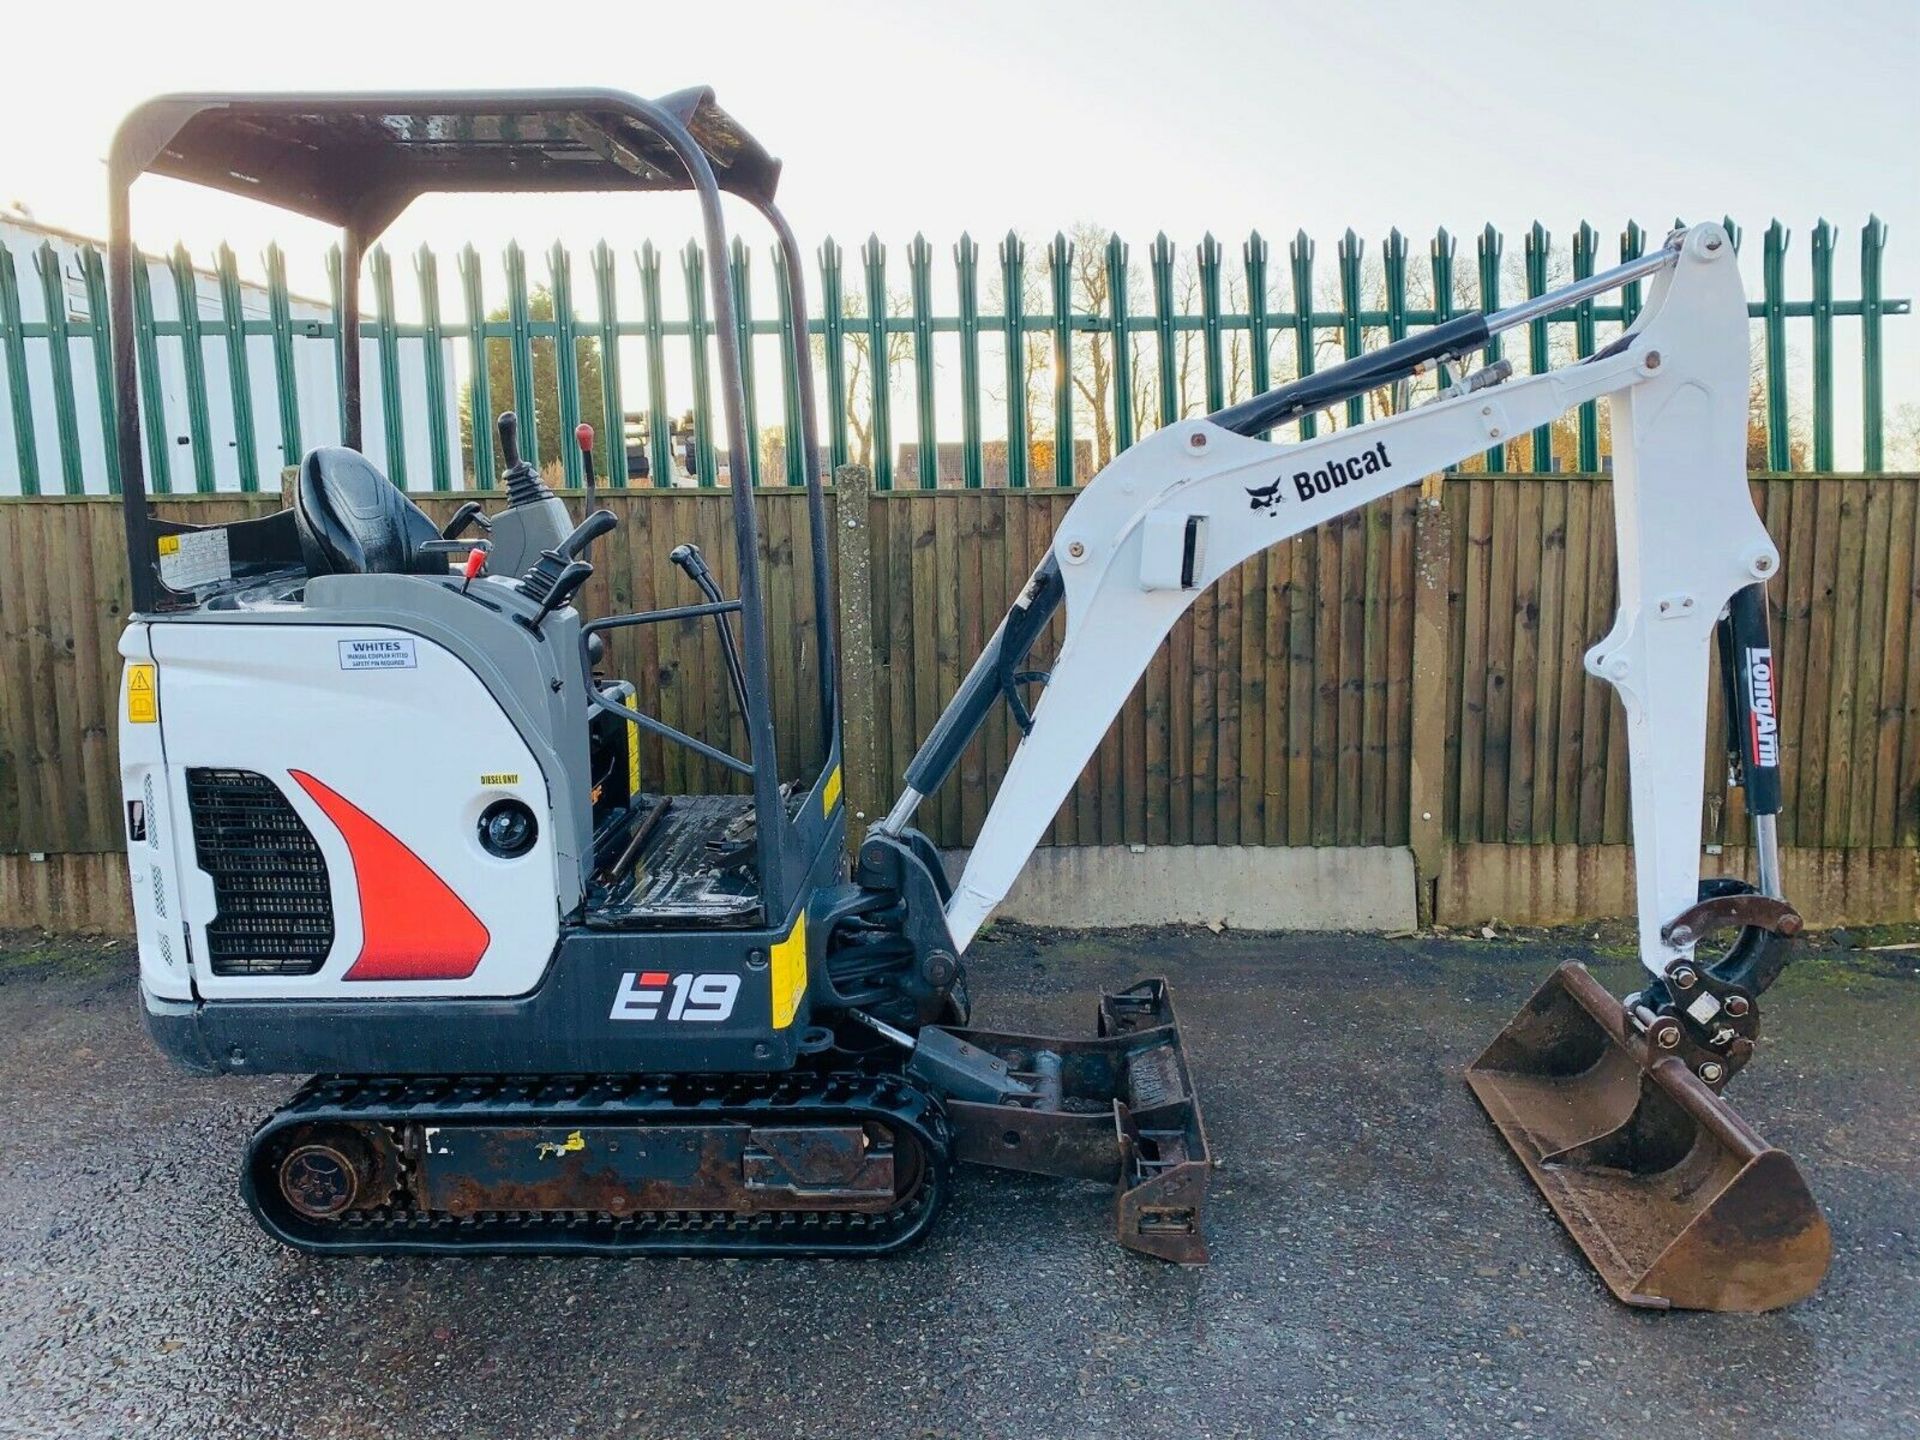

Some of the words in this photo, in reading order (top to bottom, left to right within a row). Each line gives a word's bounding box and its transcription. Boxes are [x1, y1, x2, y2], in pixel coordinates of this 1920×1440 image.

[1292, 441, 1392, 502] Bobcat
[353, 642, 401, 651] WHITES
[1745, 647, 1778, 768] LongArm
[480, 775, 502, 785] DIESEL
[502, 774, 518, 784] ONLY
[609, 972, 741, 1021] E19
